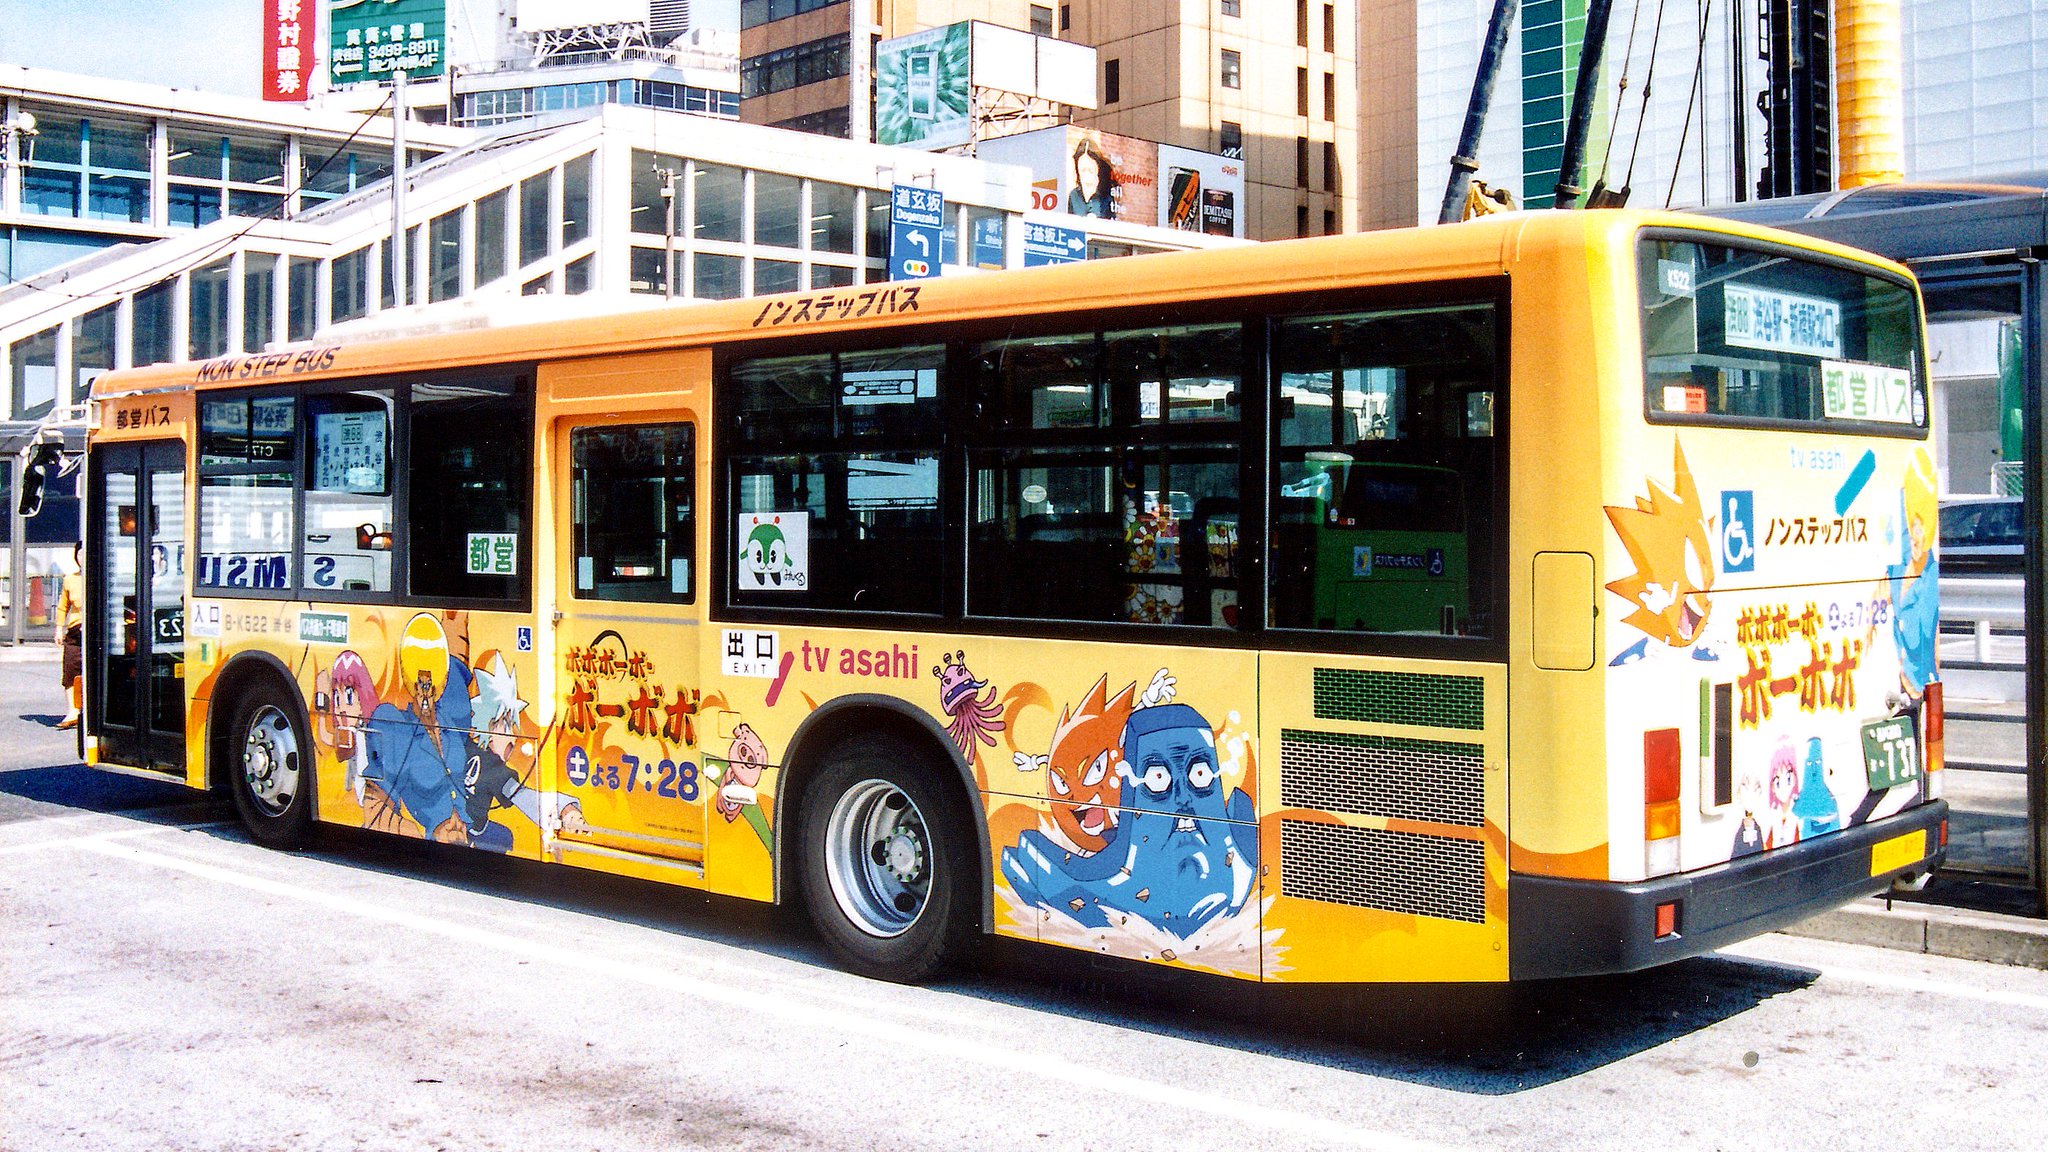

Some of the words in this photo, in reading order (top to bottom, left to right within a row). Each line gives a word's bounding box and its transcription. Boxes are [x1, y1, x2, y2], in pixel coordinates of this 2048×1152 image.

[1110, 168, 1153, 187] together
[896, 188, 941, 213] 道玄坂
[1110, 185, 1123, 198] all
[1667, 268, 1691, 291] K522
[752, 286, 922, 328] ノンステップバス
[195, 357, 241, 383] NON
[240, 352, 293, 379] STEP
[292, 346, 342, 374] BUS
[1826, 369, 1910, 417] 都営バス
[117, 405, 172, 430] 都営バス
[1764, 514, 1868, 546] ノンステップバス
[470, 535, 514, 574] 都営
[194, 604, 220, 623] 入口
[727, 631, 774, 660] 出口
[802, 639, 830, 673] tv
[839, 644, 918, 679] asahi
[733, 662, 768, 675] EXIT
